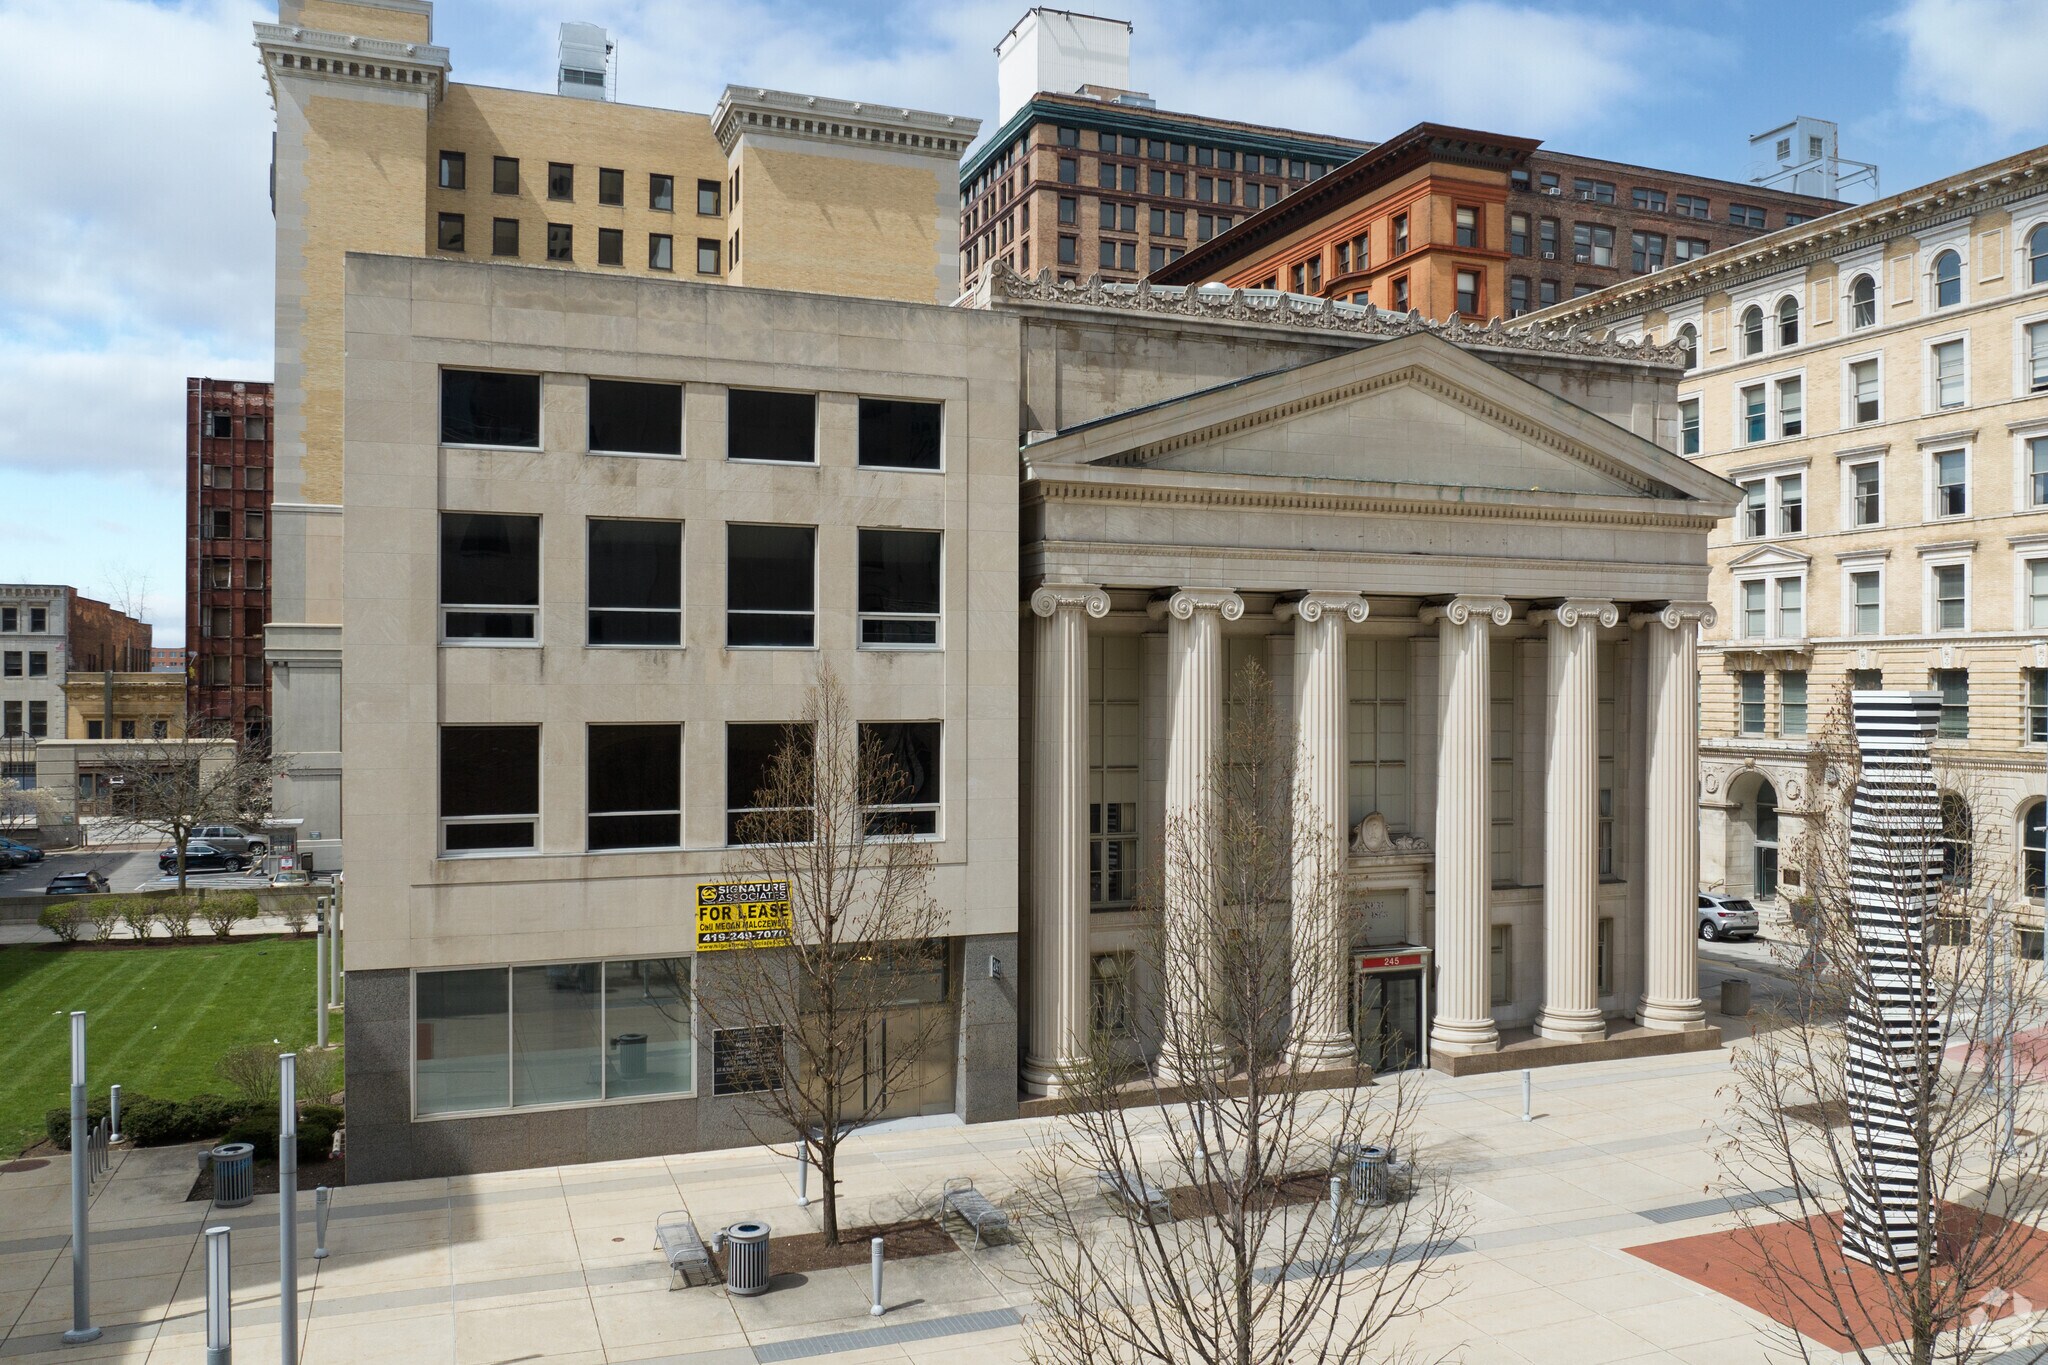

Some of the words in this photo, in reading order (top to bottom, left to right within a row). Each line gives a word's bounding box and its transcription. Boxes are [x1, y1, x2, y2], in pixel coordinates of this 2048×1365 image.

[718, 883, 786, 894] SIGNATURE
[700, 906, 732, 921] FOR
[738, 903, 789, 919] LEASE
[700, 923, 713, 931] Call
[1384, 957, 1400, 966] 245
